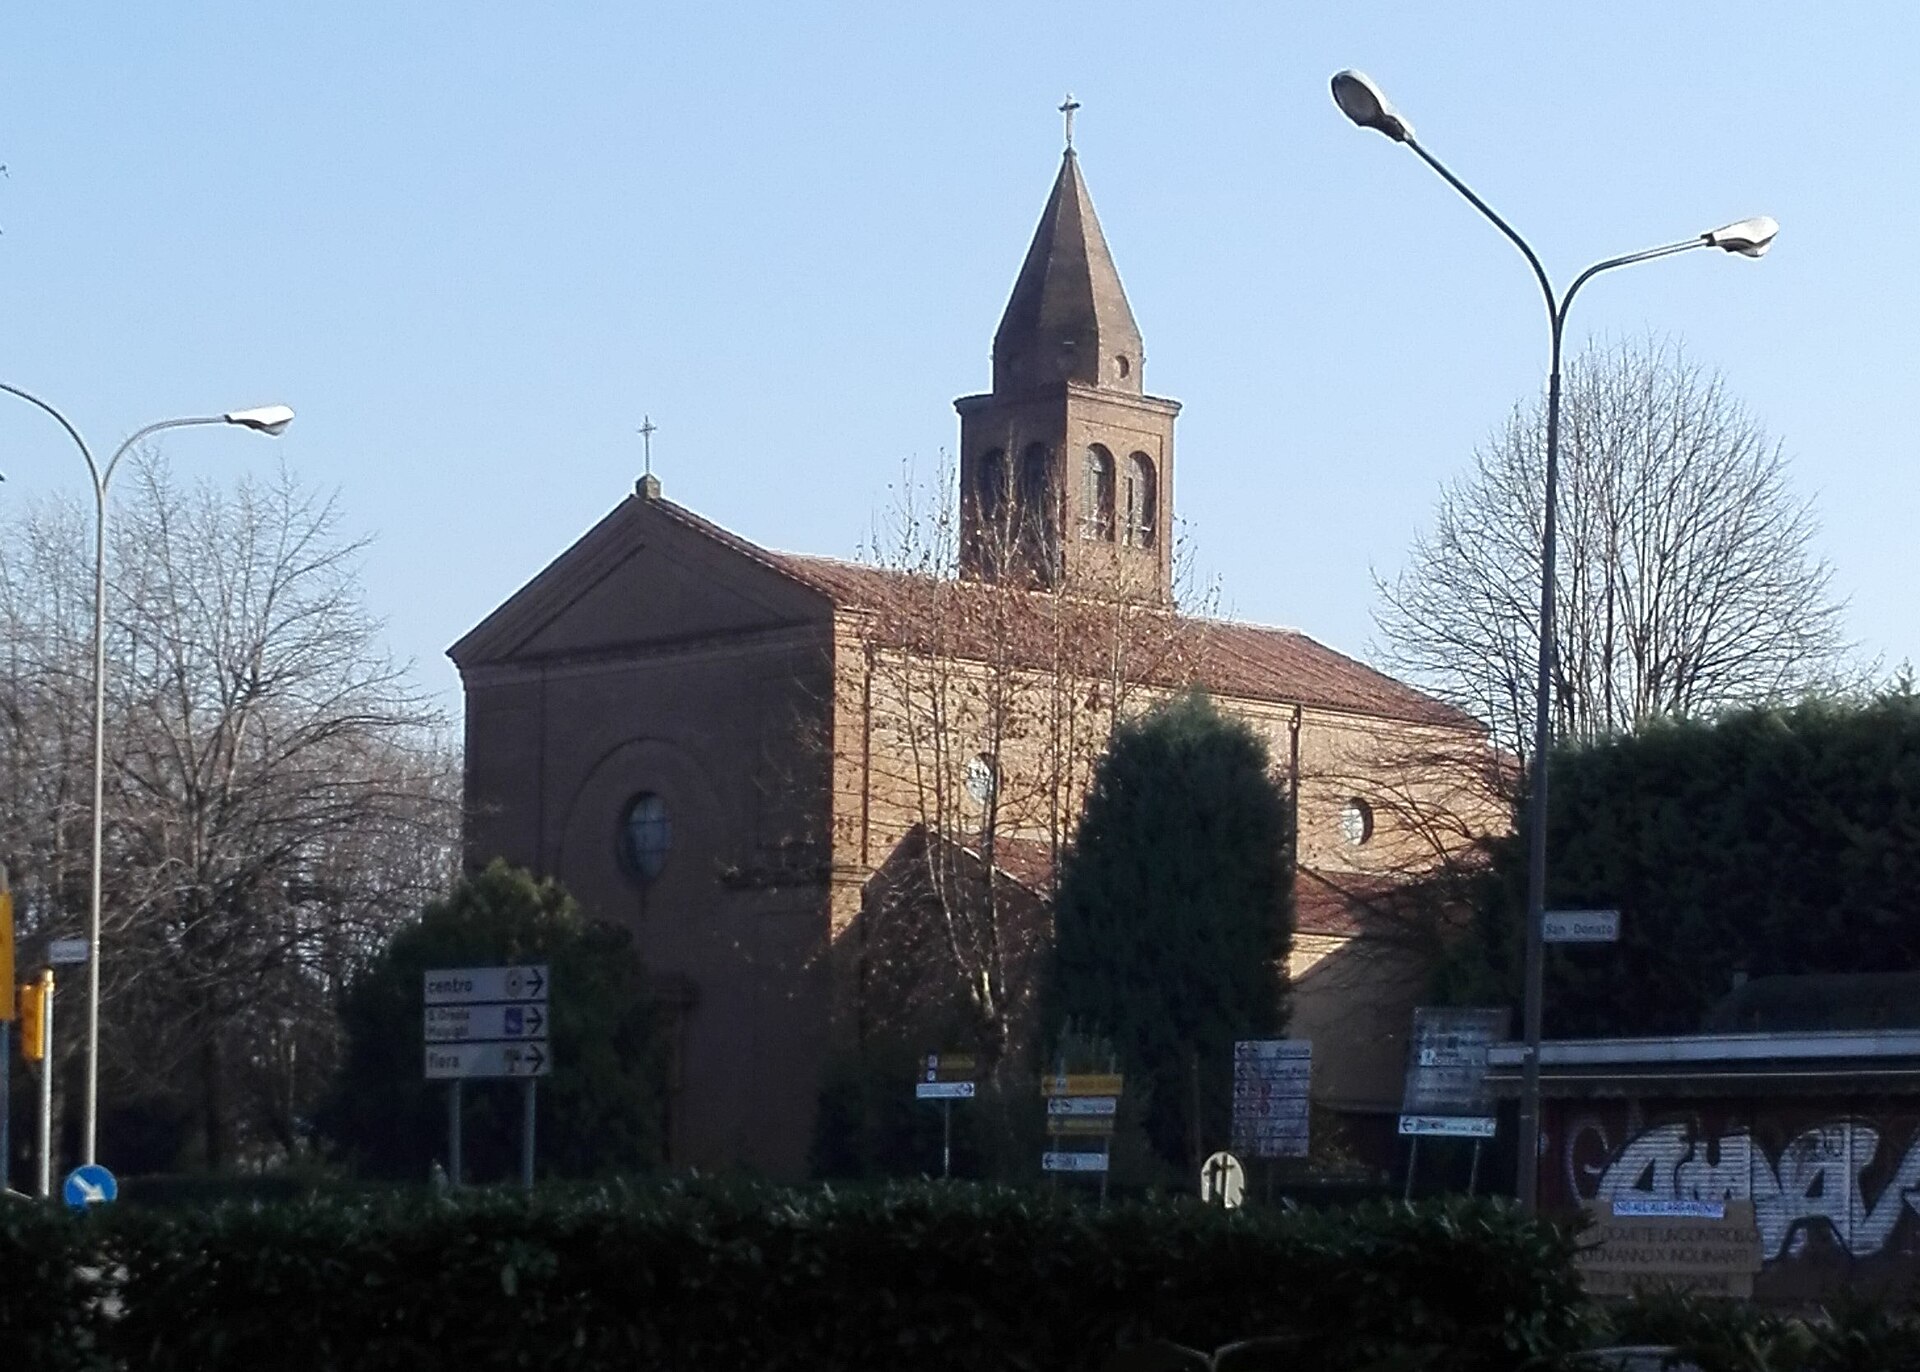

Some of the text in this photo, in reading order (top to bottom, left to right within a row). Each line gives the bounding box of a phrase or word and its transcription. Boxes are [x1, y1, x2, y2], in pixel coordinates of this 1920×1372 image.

[1546, 923, 1567, 935] San
[428, 978, 472, 993] centro
[429, 1052, 460, 1068] fiera
